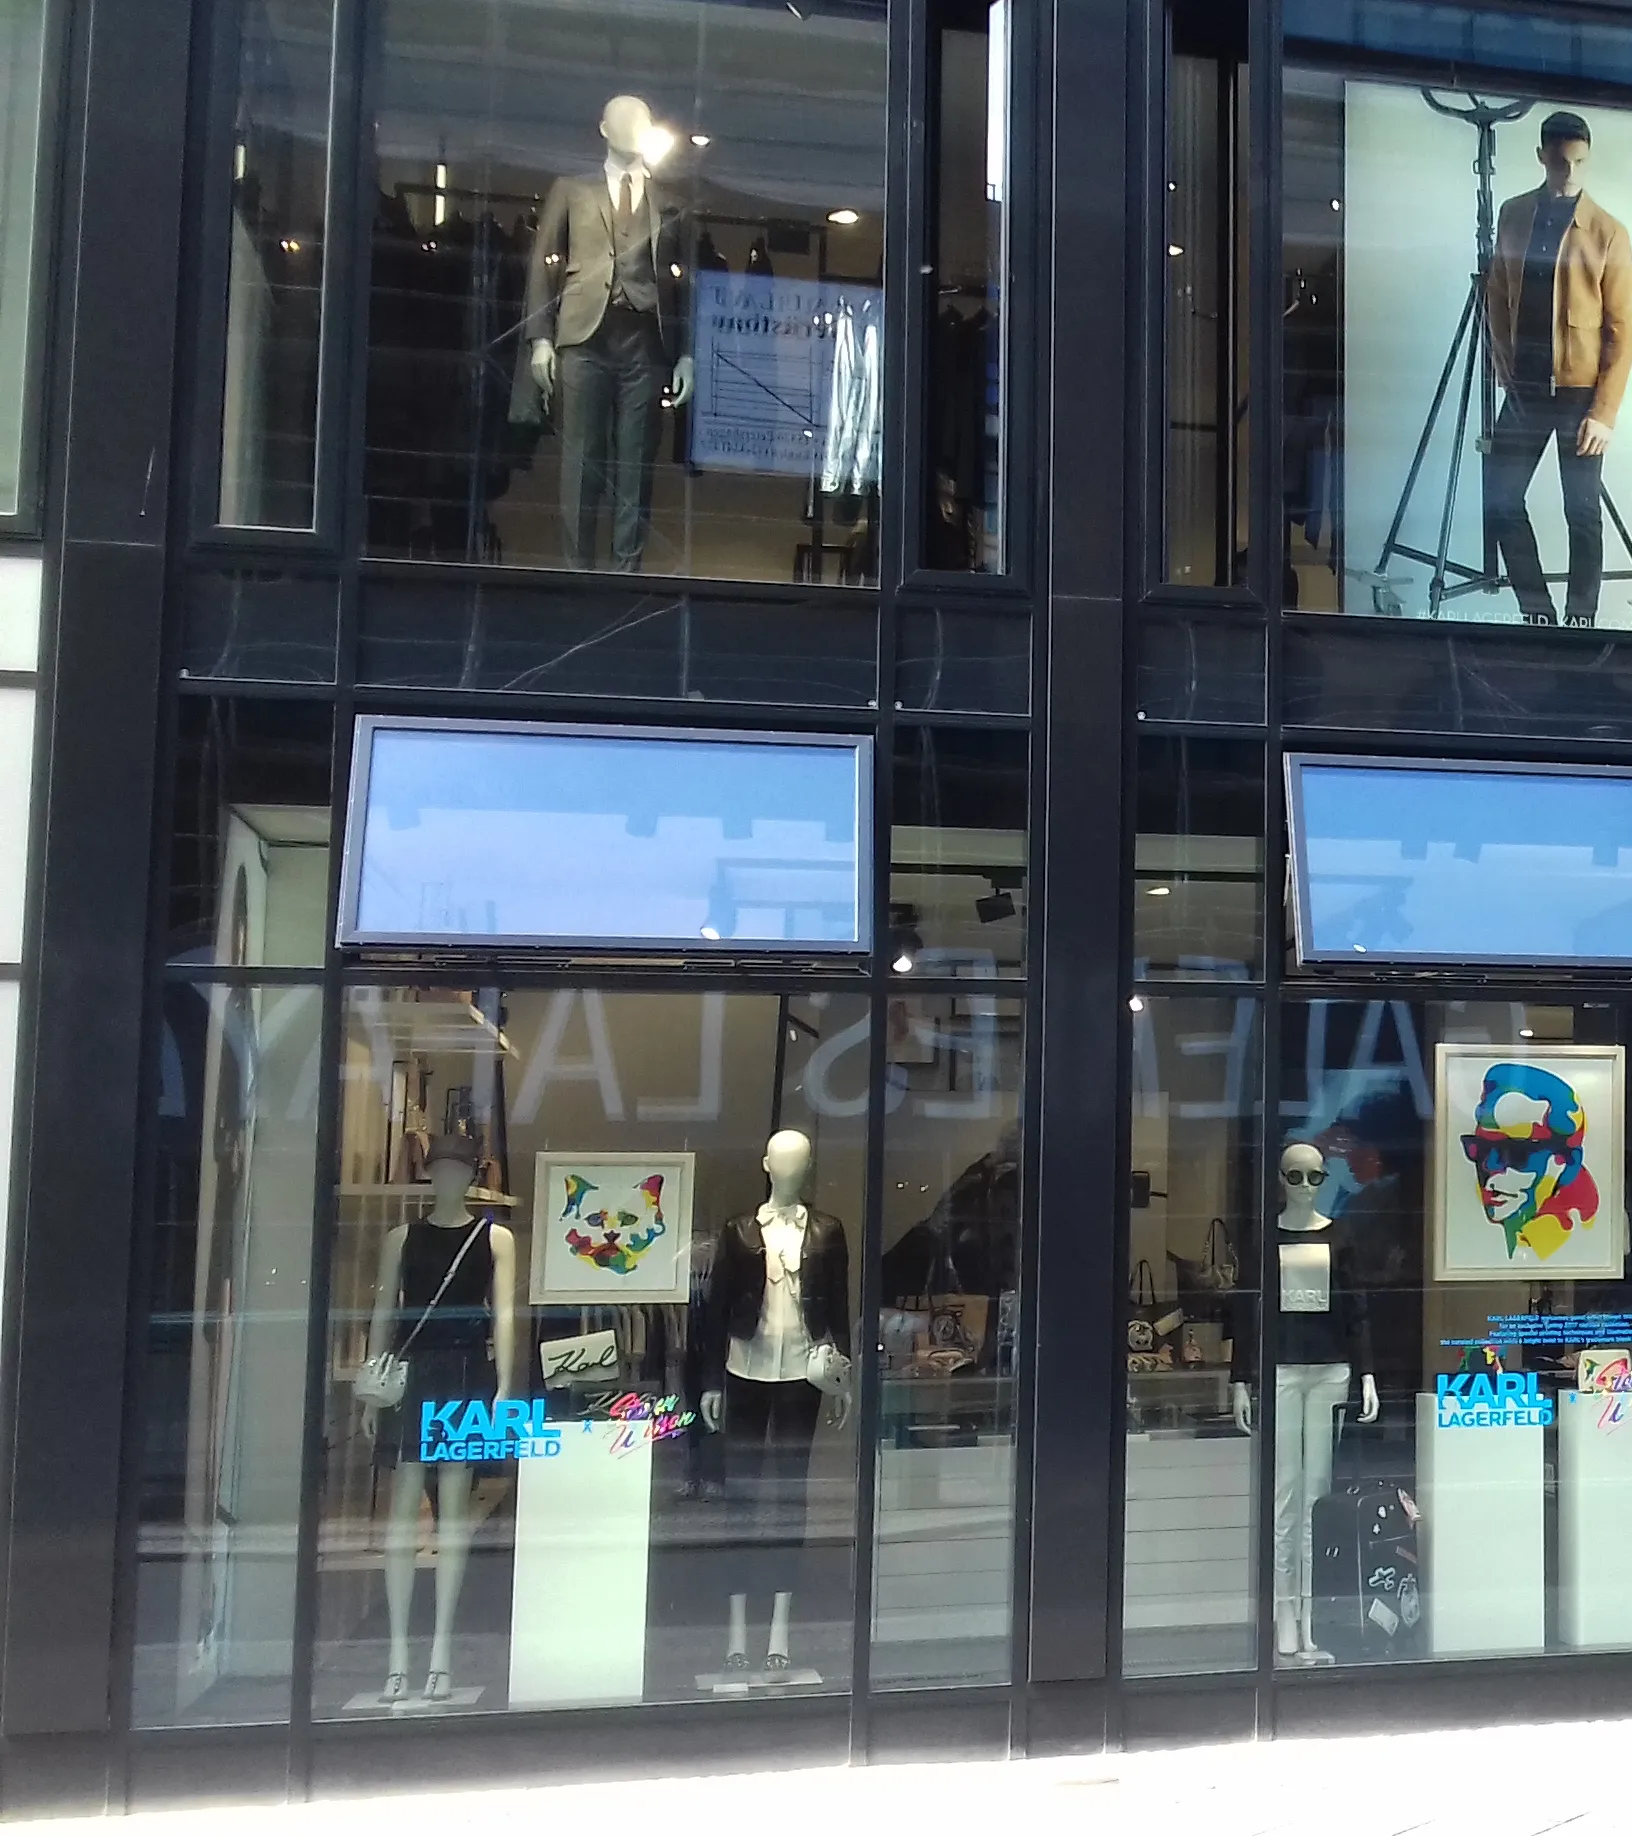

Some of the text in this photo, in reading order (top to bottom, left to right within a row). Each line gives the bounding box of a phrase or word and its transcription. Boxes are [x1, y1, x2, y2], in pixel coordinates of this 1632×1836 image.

[545, 1344, 618, 1380] Karl
[1436, 1371, 1553, 1411] KARL
[420, 1398, 562, 1442] KARL
[1437, 1410, 1554, 1429] LAGERFELD
[420, 1440, 561, 1462] LAGERFELD
